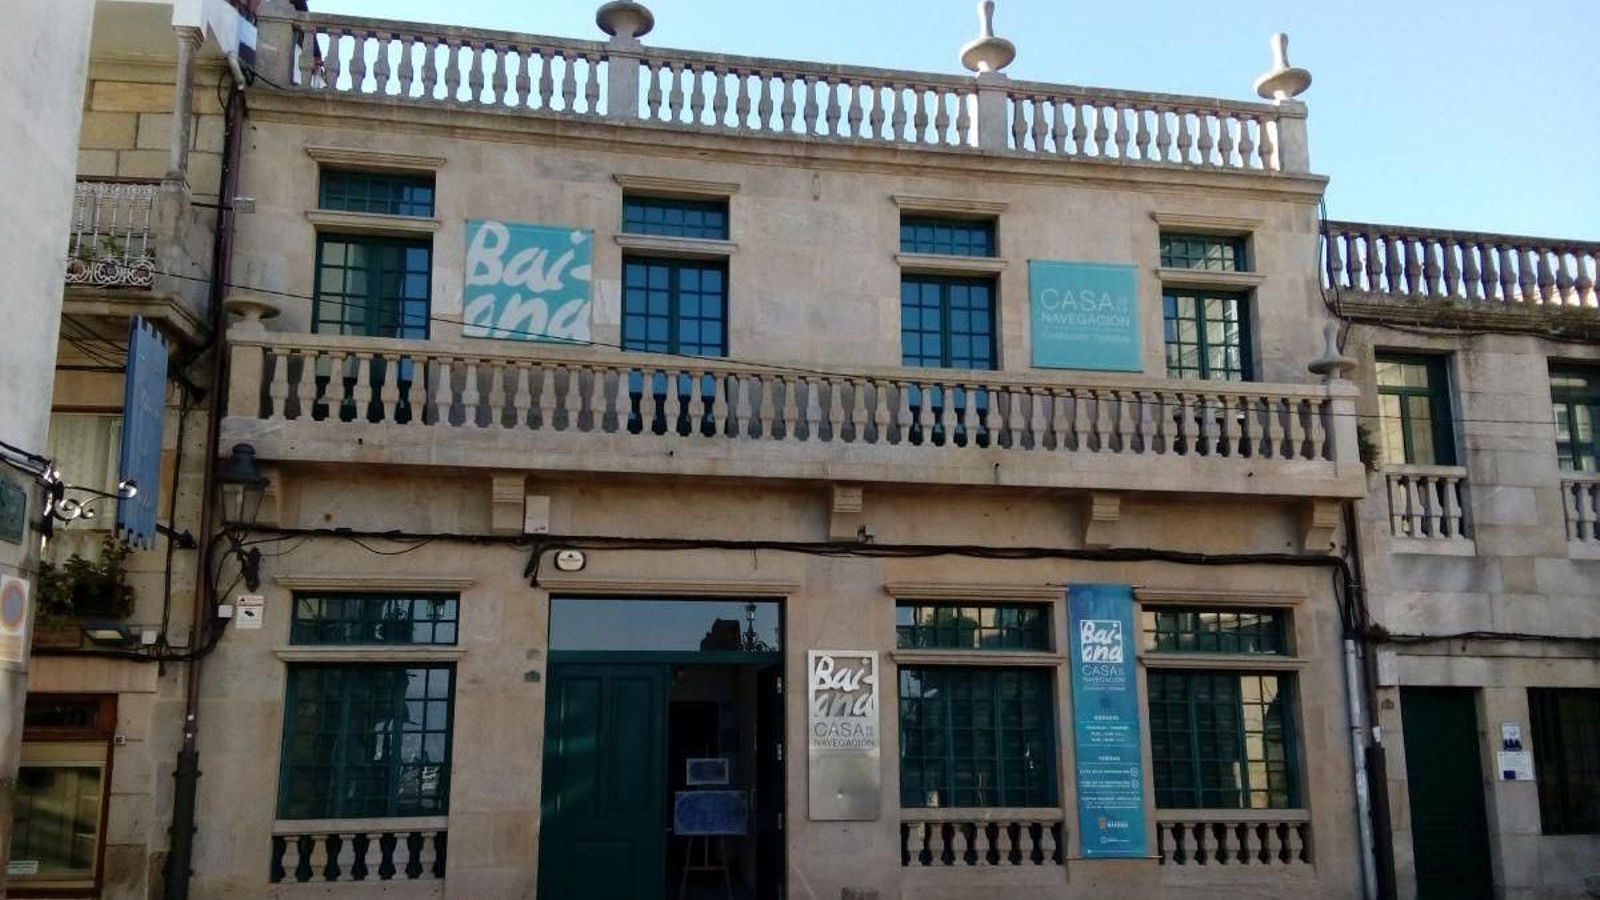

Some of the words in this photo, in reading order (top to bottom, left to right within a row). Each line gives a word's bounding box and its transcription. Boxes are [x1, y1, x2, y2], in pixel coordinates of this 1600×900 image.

[1040, 287, 1114, 312] CASA
[1041, 311, 1130, 328] NAVEGACIÓN
[1082, 664, 1118, 677] CASA
[814, 721, 865, 738] CASA
